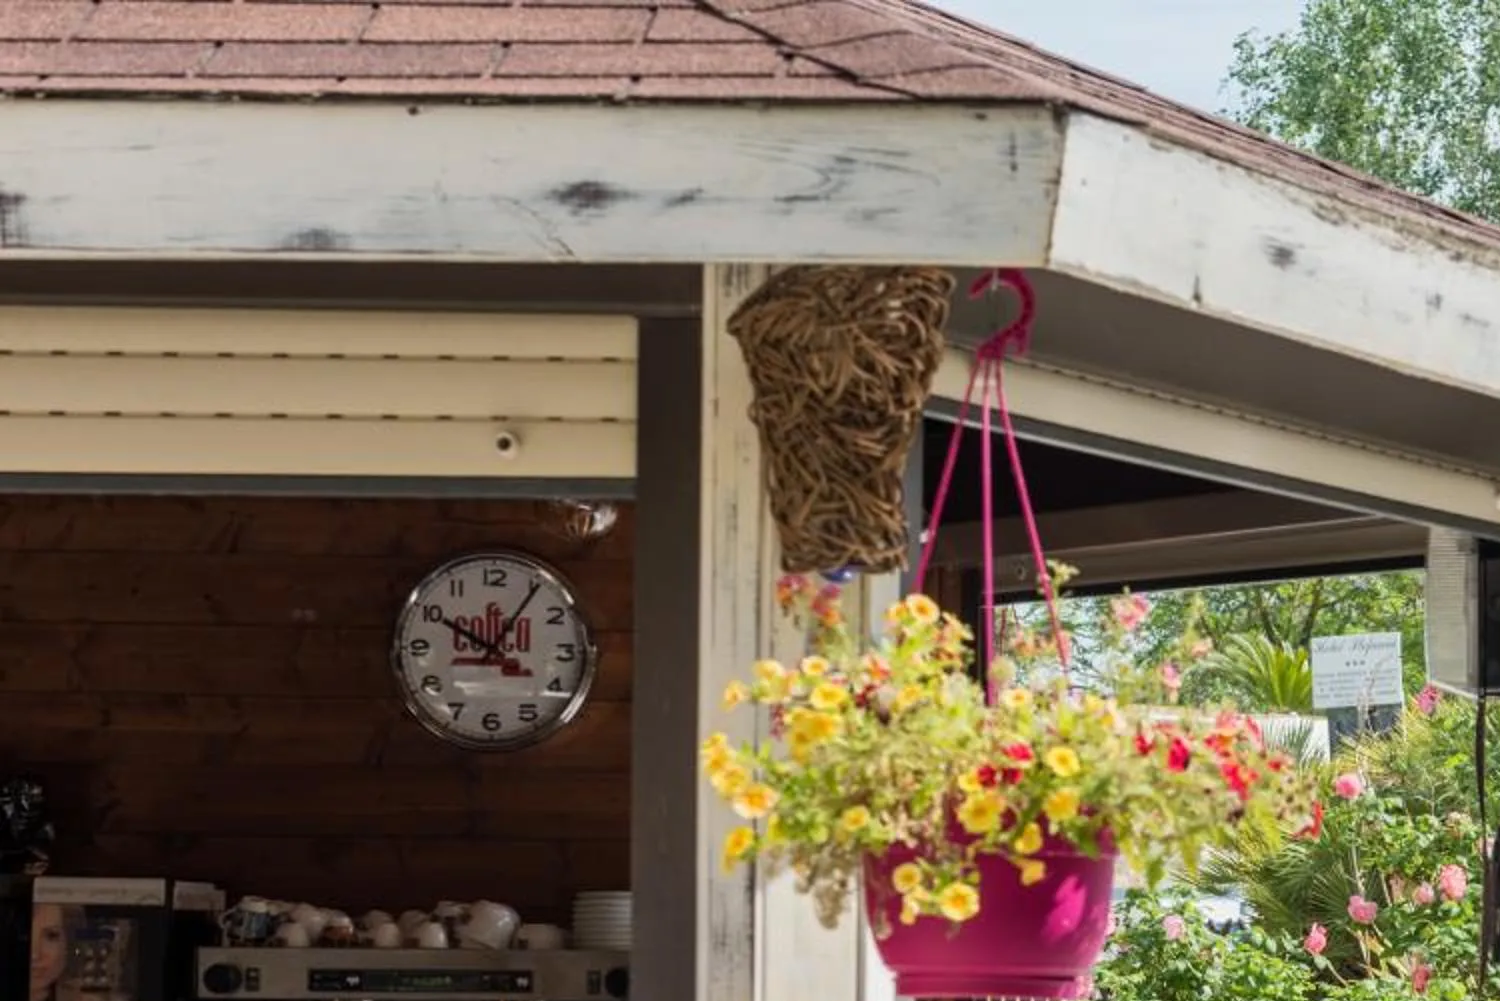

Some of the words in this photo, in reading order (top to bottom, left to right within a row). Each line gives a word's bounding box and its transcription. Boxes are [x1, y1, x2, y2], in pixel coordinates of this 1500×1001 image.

[483, 568, 507, 587] 12
[451, 580, 464, 597] 11
[422, 604, 443, 623] 10
[546, 607, 565, 625] 2
[410, 638, 430, 657] 9
[556, 643, 575, 662] 3
[422, 675, 442, 693] 8
[547, 678, 563, 694] 4
[447, 702, 464, 721] 7
[518, 703, 538, 722] 5
[481, 713, 502, 731] 6
